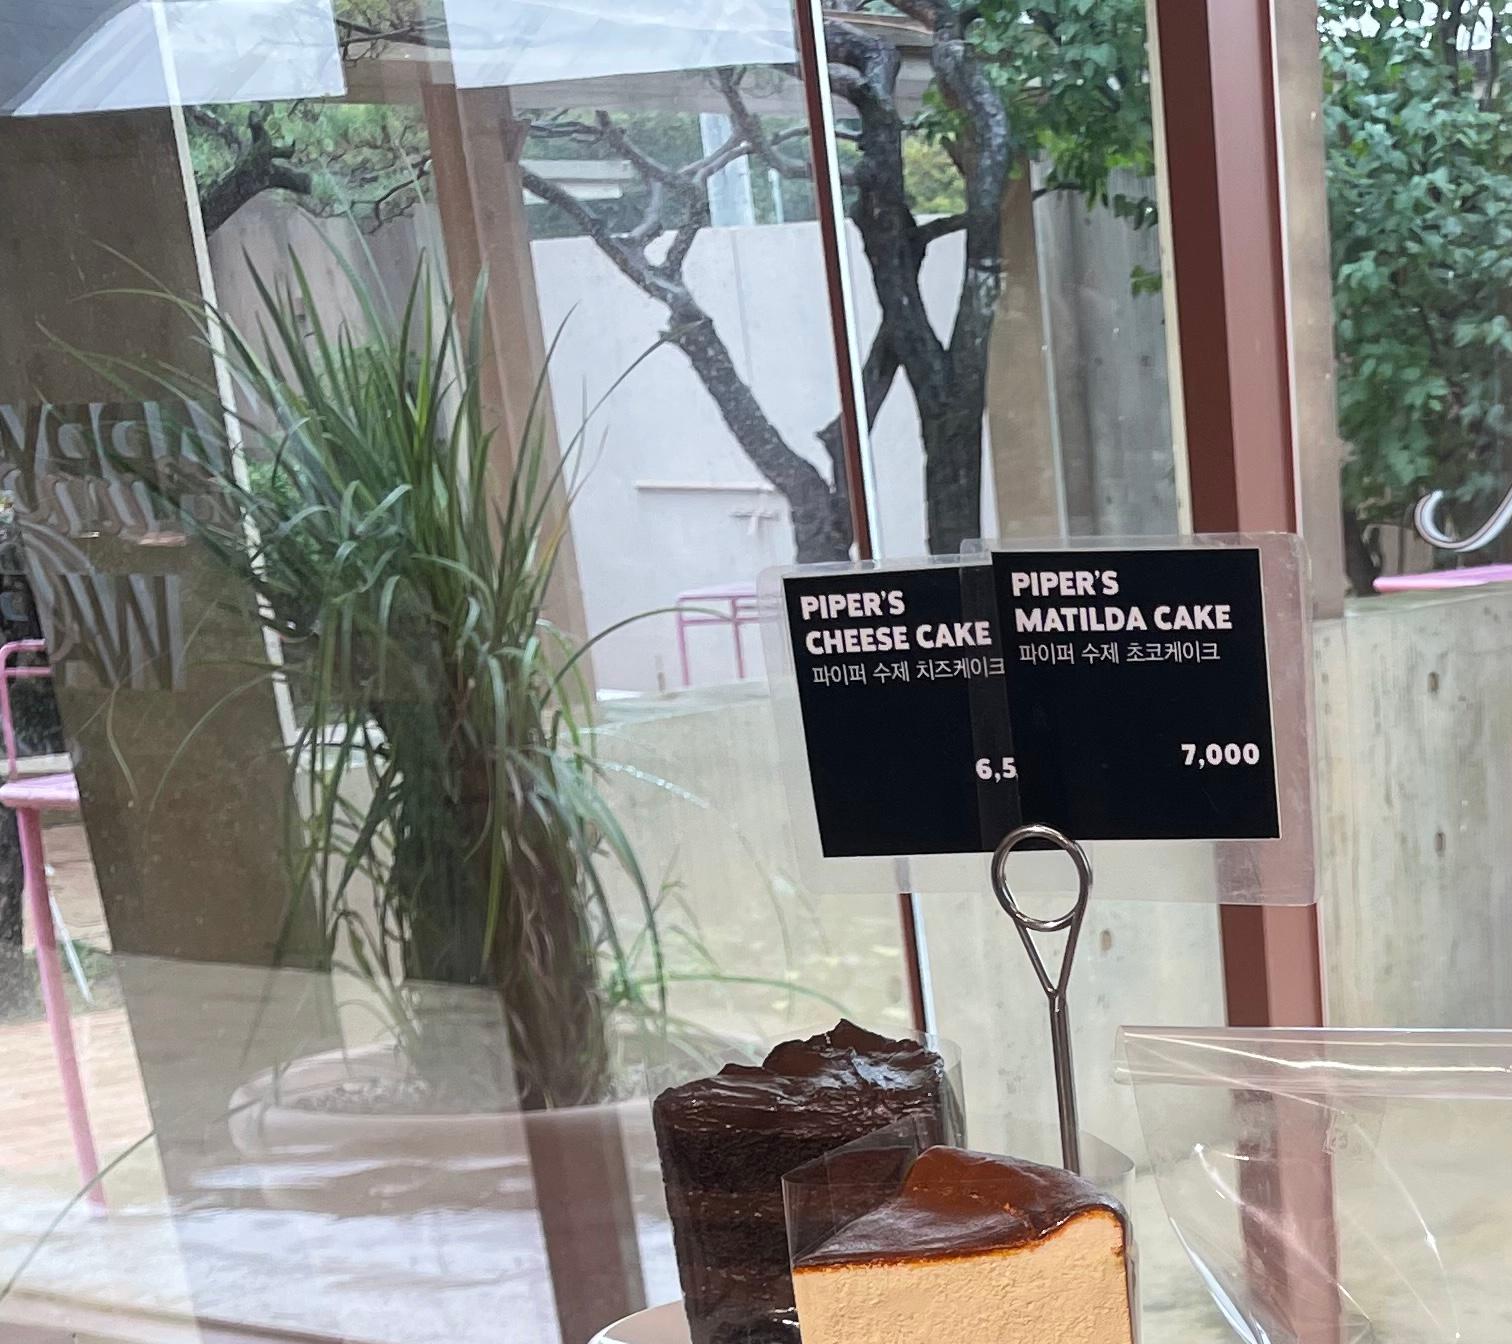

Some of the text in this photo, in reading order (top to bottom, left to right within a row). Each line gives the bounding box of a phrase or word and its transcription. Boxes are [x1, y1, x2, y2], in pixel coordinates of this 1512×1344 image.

[1015, 605, 1232, 632] MATILDA CAKE
[806, 621, 992, 654] CHEESE CAKE
[1019, 641, 1221, 665] 파이퍼 수제 초코케이크
[812, 656, 1006, 687] 파이퍼 수제 치즈케이크
[976, 757, 1018, 782] 6,5
[1181, 743, 1260, 770] 7,000
